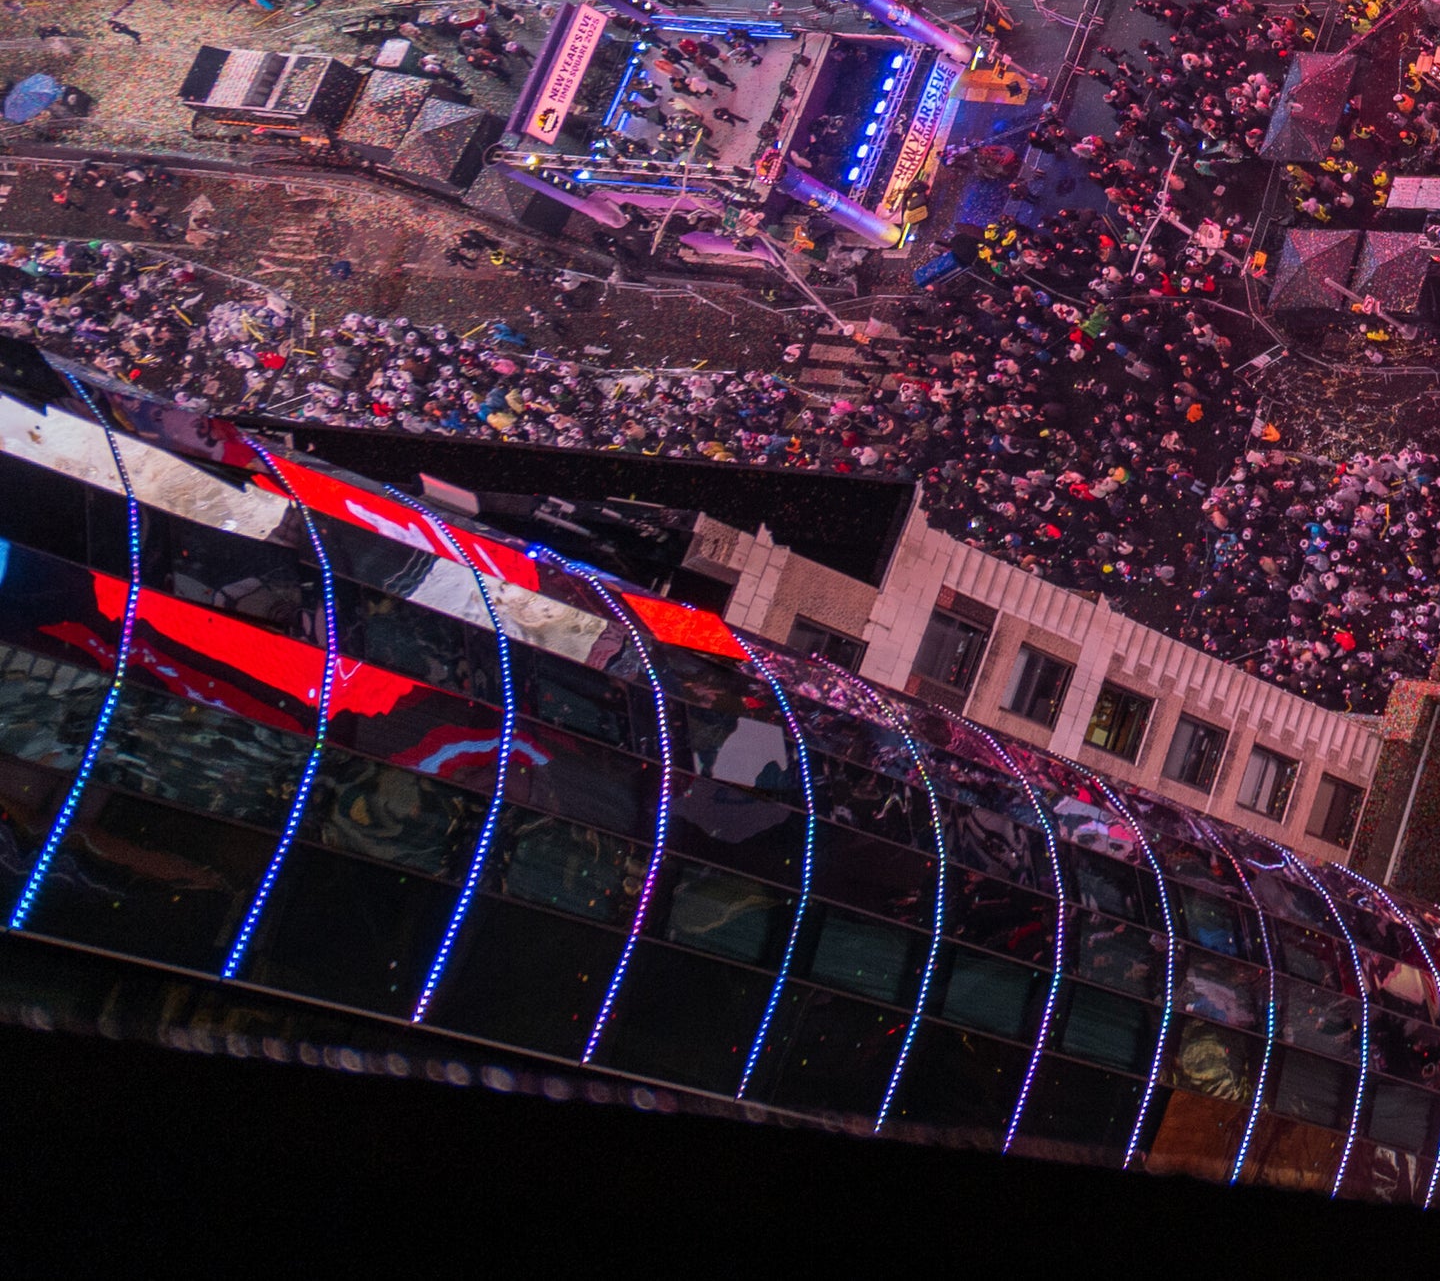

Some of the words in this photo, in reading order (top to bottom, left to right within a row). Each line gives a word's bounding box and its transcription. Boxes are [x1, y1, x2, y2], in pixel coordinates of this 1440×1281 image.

[549, 69, 564, 101] NEW
[561, 33, 583, 74] YEAR'S
[580, 12, 594, 36] EVE
[557, 77, 574, 104] TIMES
[570, 43, 589, 80] SQUARE
[585, 17, 600, 45] 2025
[940, 68, 957, 105] 2025
[893, 146, 916, 181] NEW
[909, 92, 937, 148] YEAR'S
[931, 62, 949, 92] EVE
